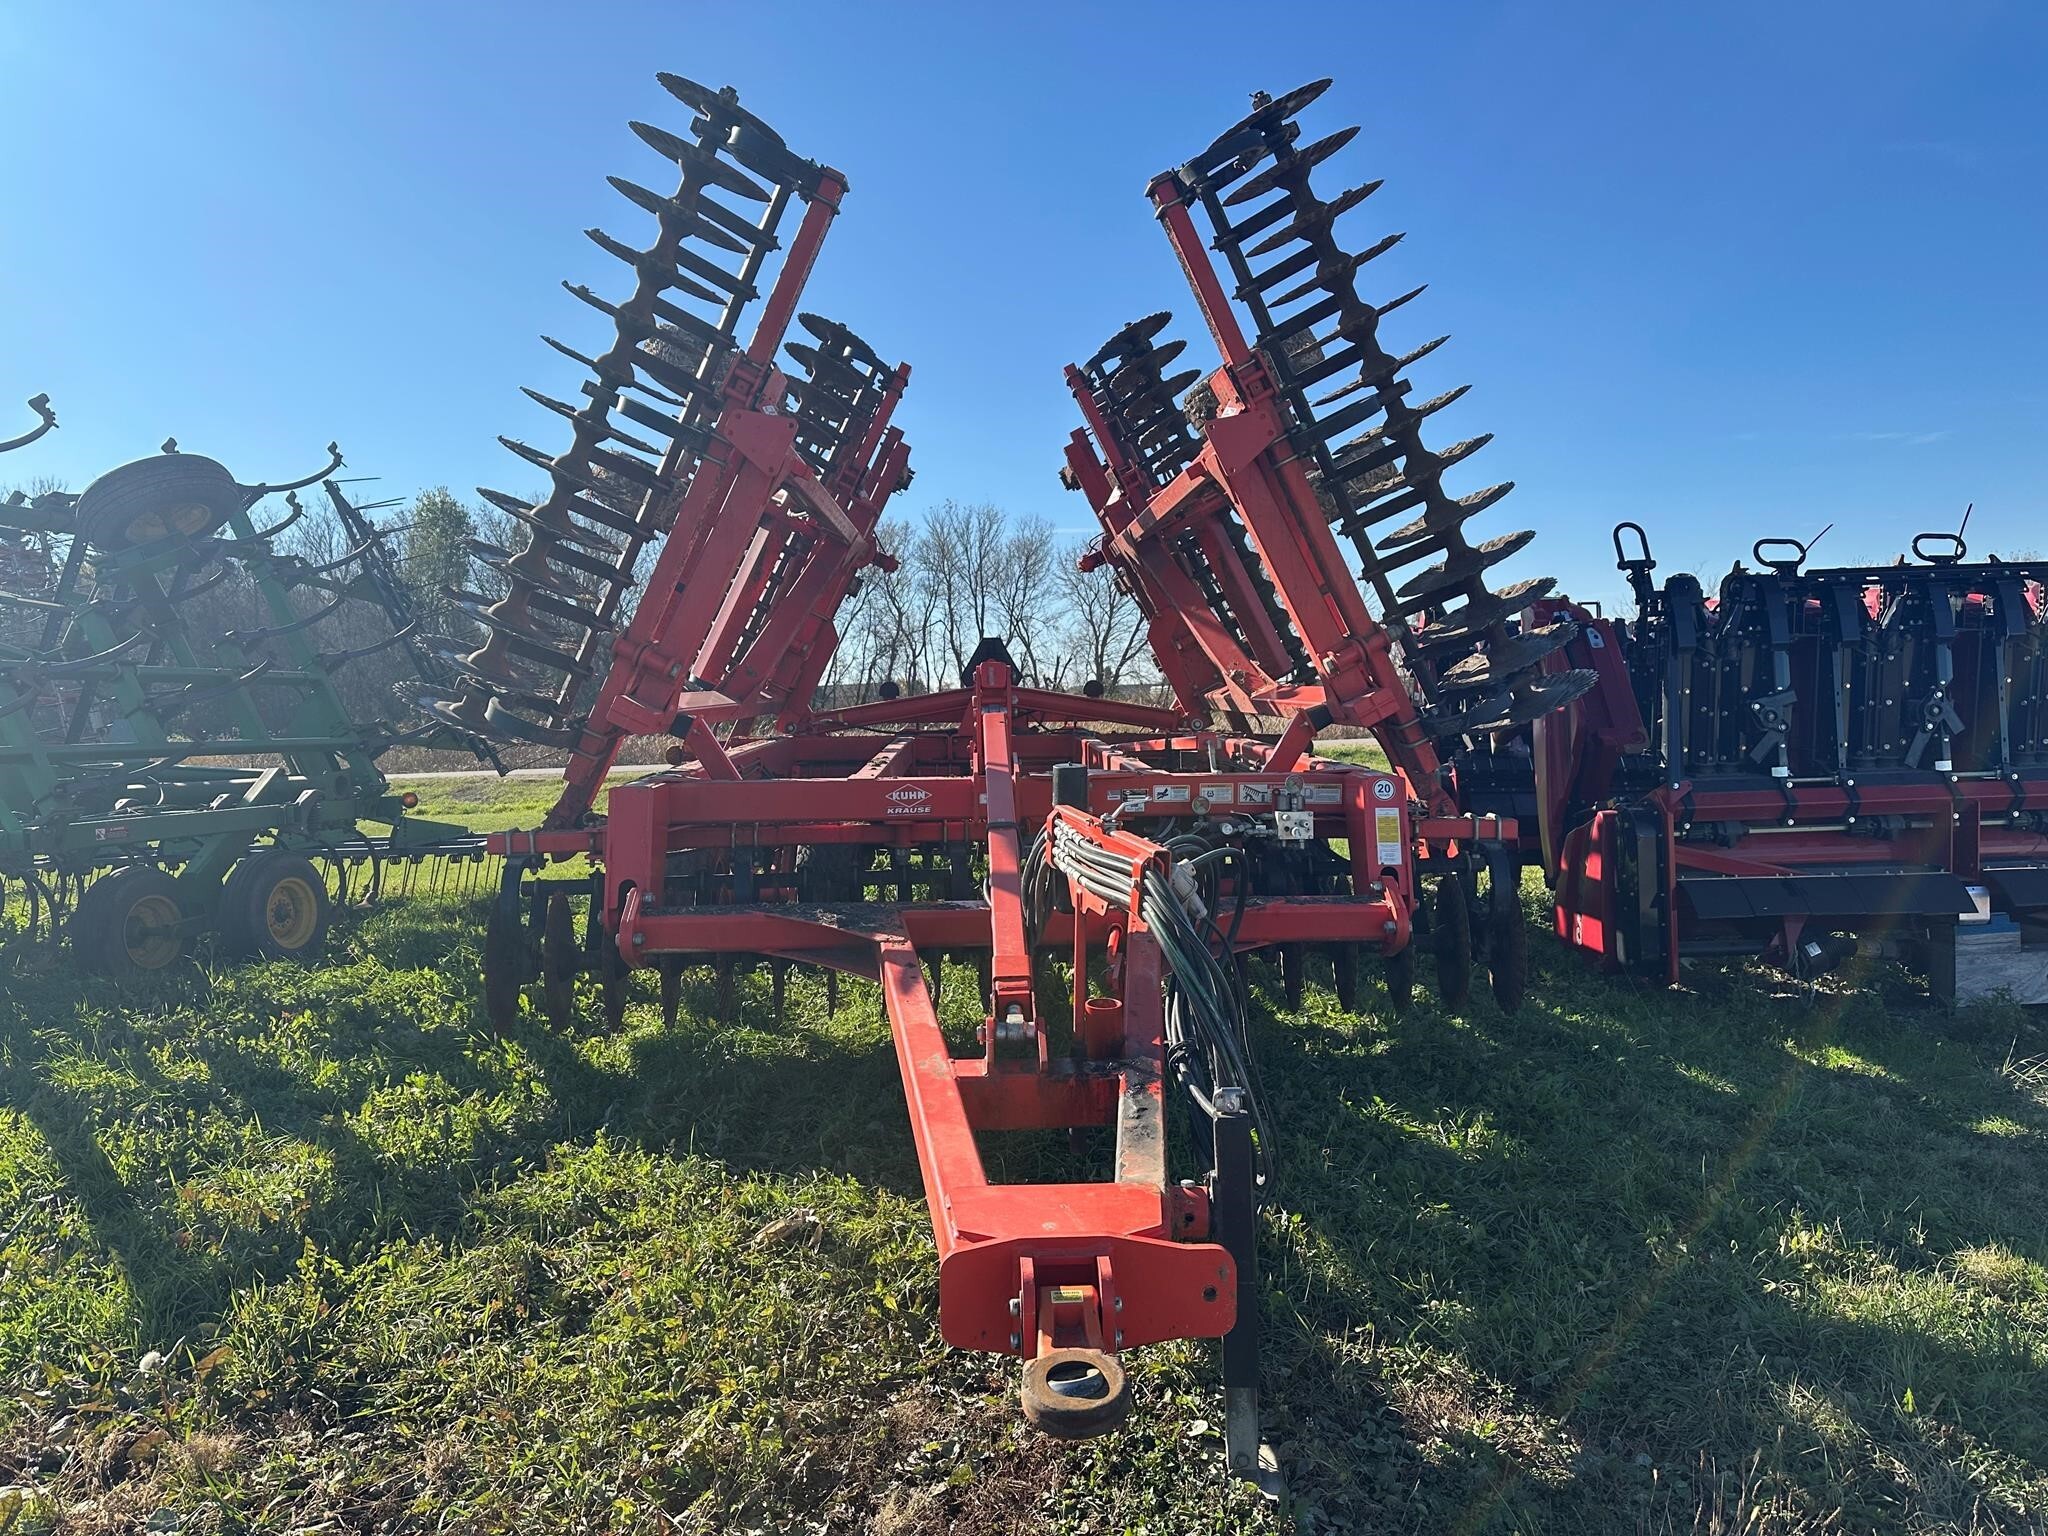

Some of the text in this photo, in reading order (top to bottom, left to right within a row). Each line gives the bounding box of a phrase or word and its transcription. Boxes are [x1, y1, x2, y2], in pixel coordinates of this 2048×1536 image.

[1377, 784, 1391, 793] 20
[892, 791, 926, 800] KUHN
[887, 806, 931, 814] KRAUSE
